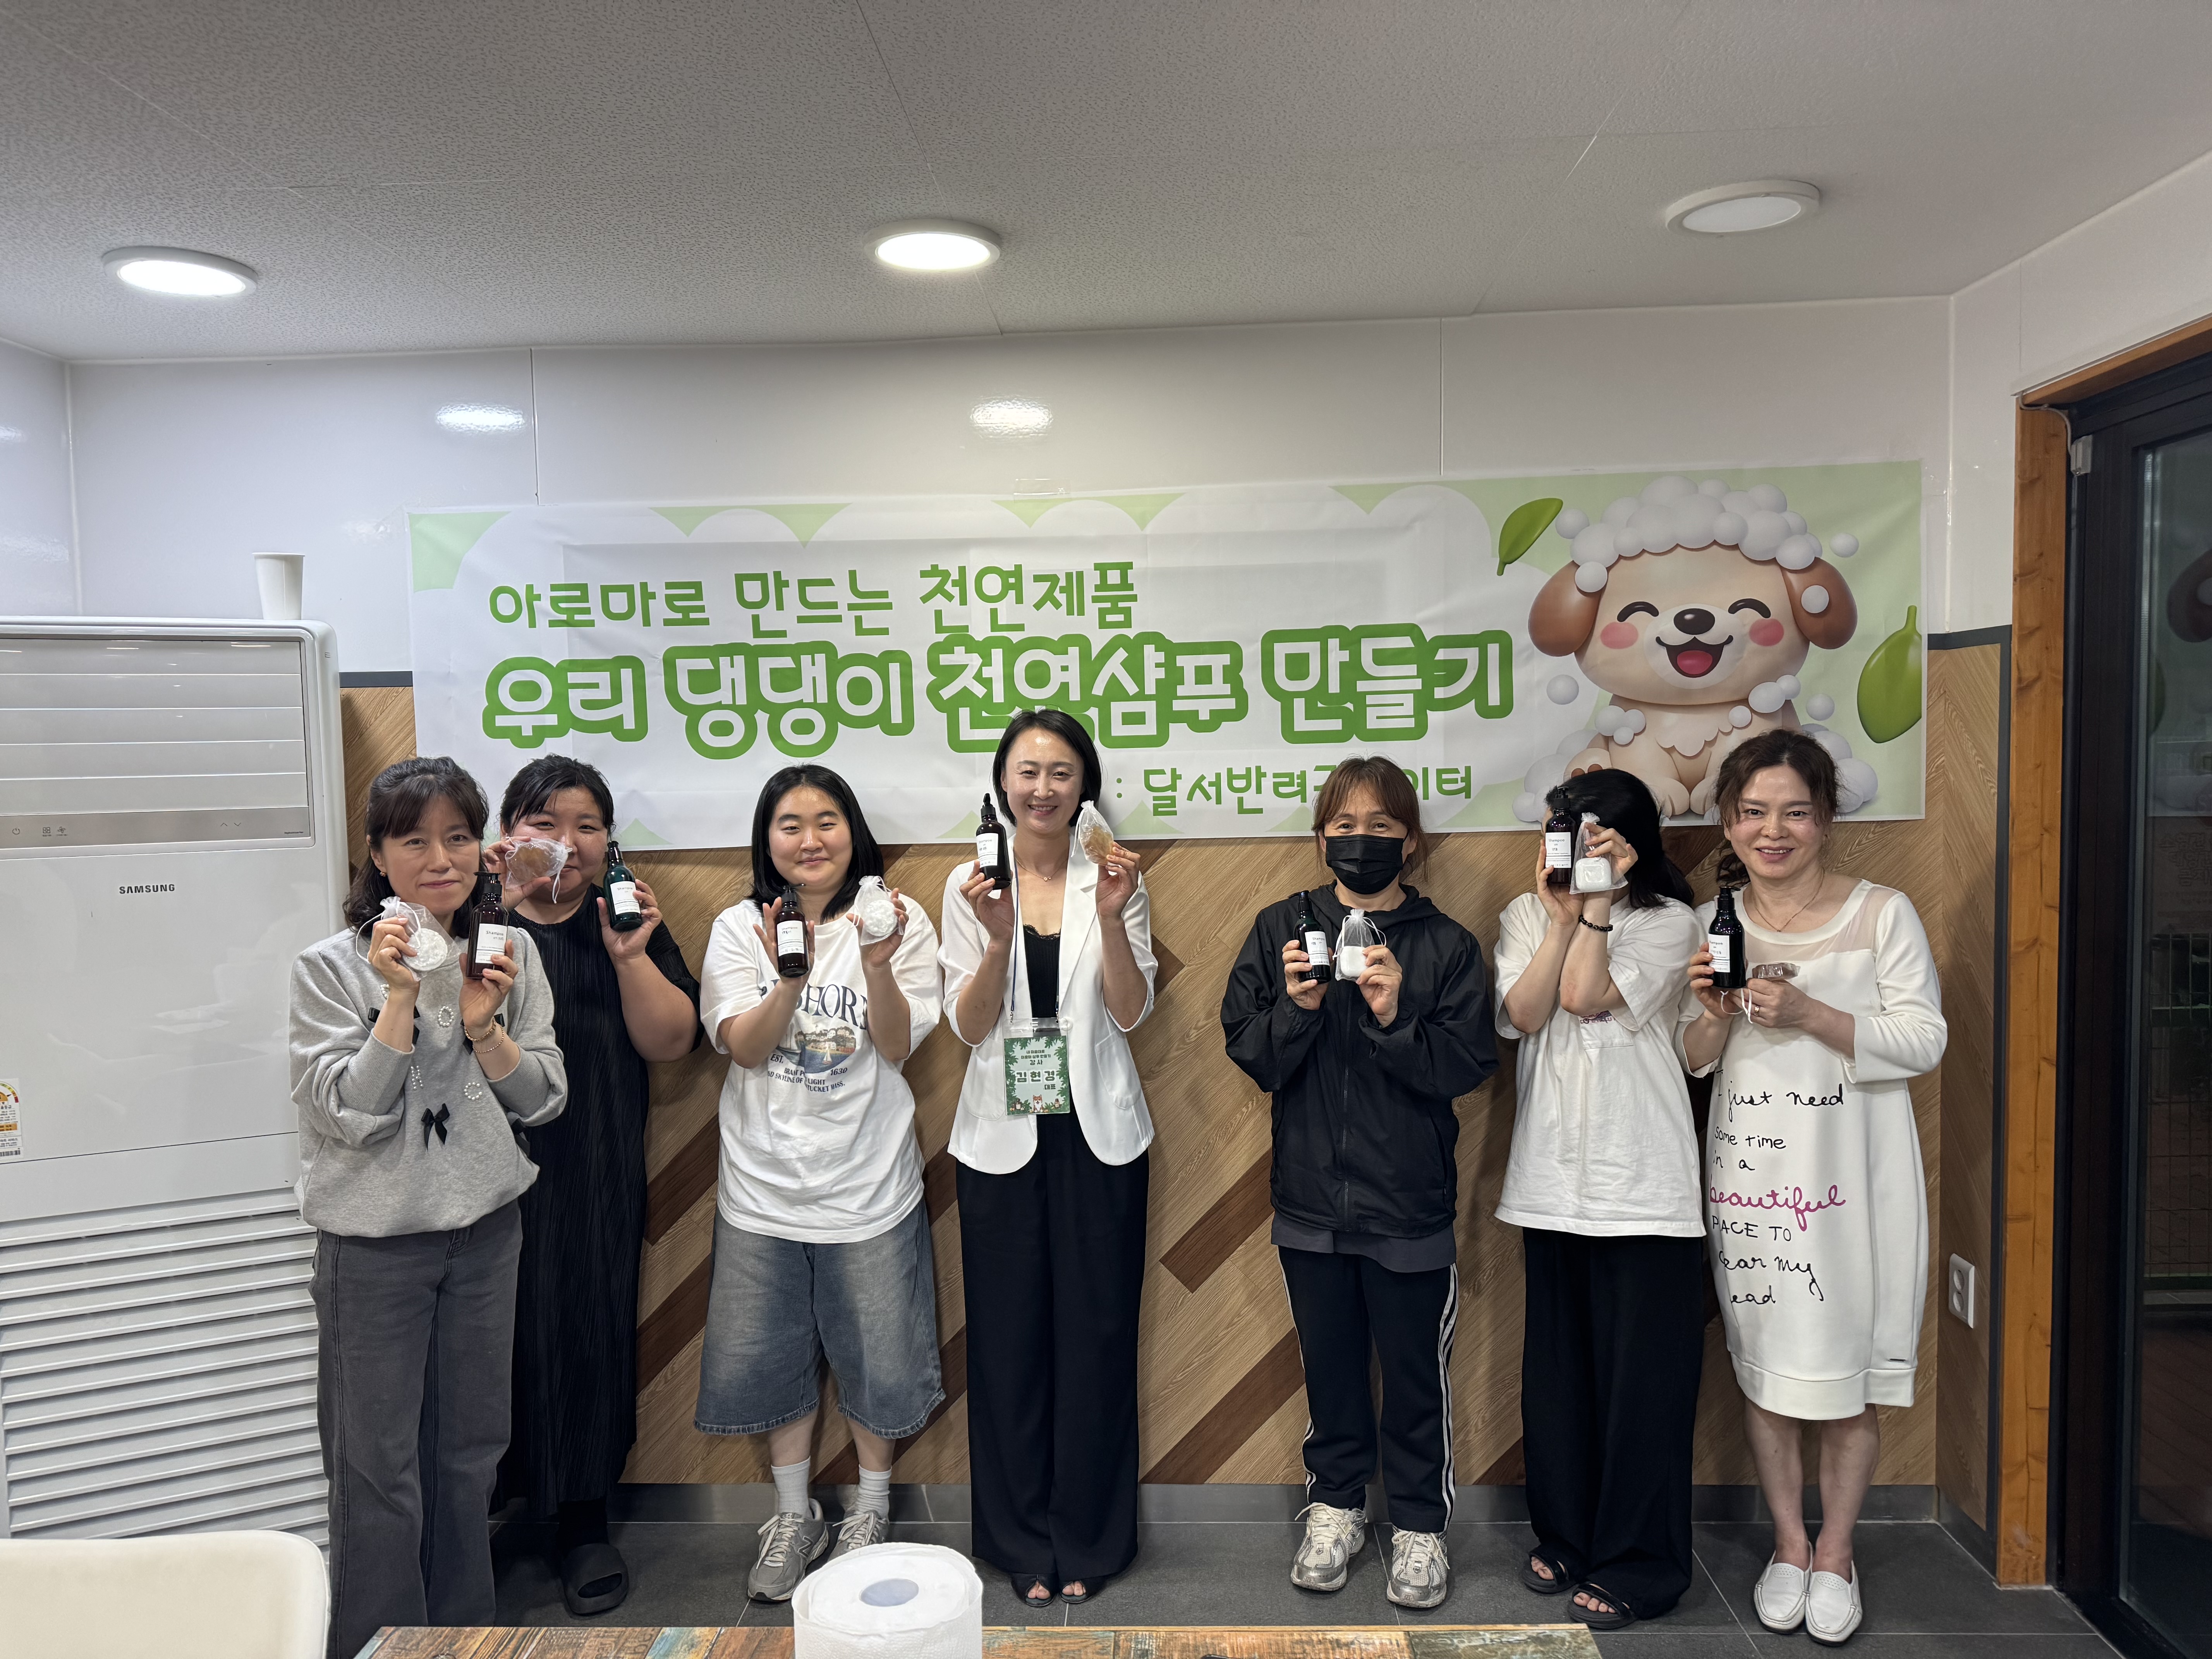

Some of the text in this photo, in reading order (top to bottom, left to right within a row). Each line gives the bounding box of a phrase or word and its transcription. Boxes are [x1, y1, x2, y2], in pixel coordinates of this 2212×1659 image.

[489, 562, 1138, 639] 아로마로 만드는 천연제품
[490, 662, 641, 740] 우리
[669, 646, 908, 753] 댕댕이
[1267, 630, 1506, 737] 만들기
[1143, 764, 1472, 816] 달서반려이터
[119, 884, 175, 894] SAMSUNG
[770, 1054, 784, 1063] EST.
[830, 1067, 848, 1076] 1630
[1016, 1070, 1055, 1083] 김현경
[1728, 1080, 1772, 1123] just
[1786, 1083, 1844, 1107] need
[1745, 1135, 1786, 1149] time
[1738, 1159, 1755, 1171] a
[1710, 1173, 1846, 1232] beautiful
[1768, 1226, 1791, 1242] TO
[1774, 1256, 1824, 1302] my
[1730, 1285, 1776, 1305] ead
